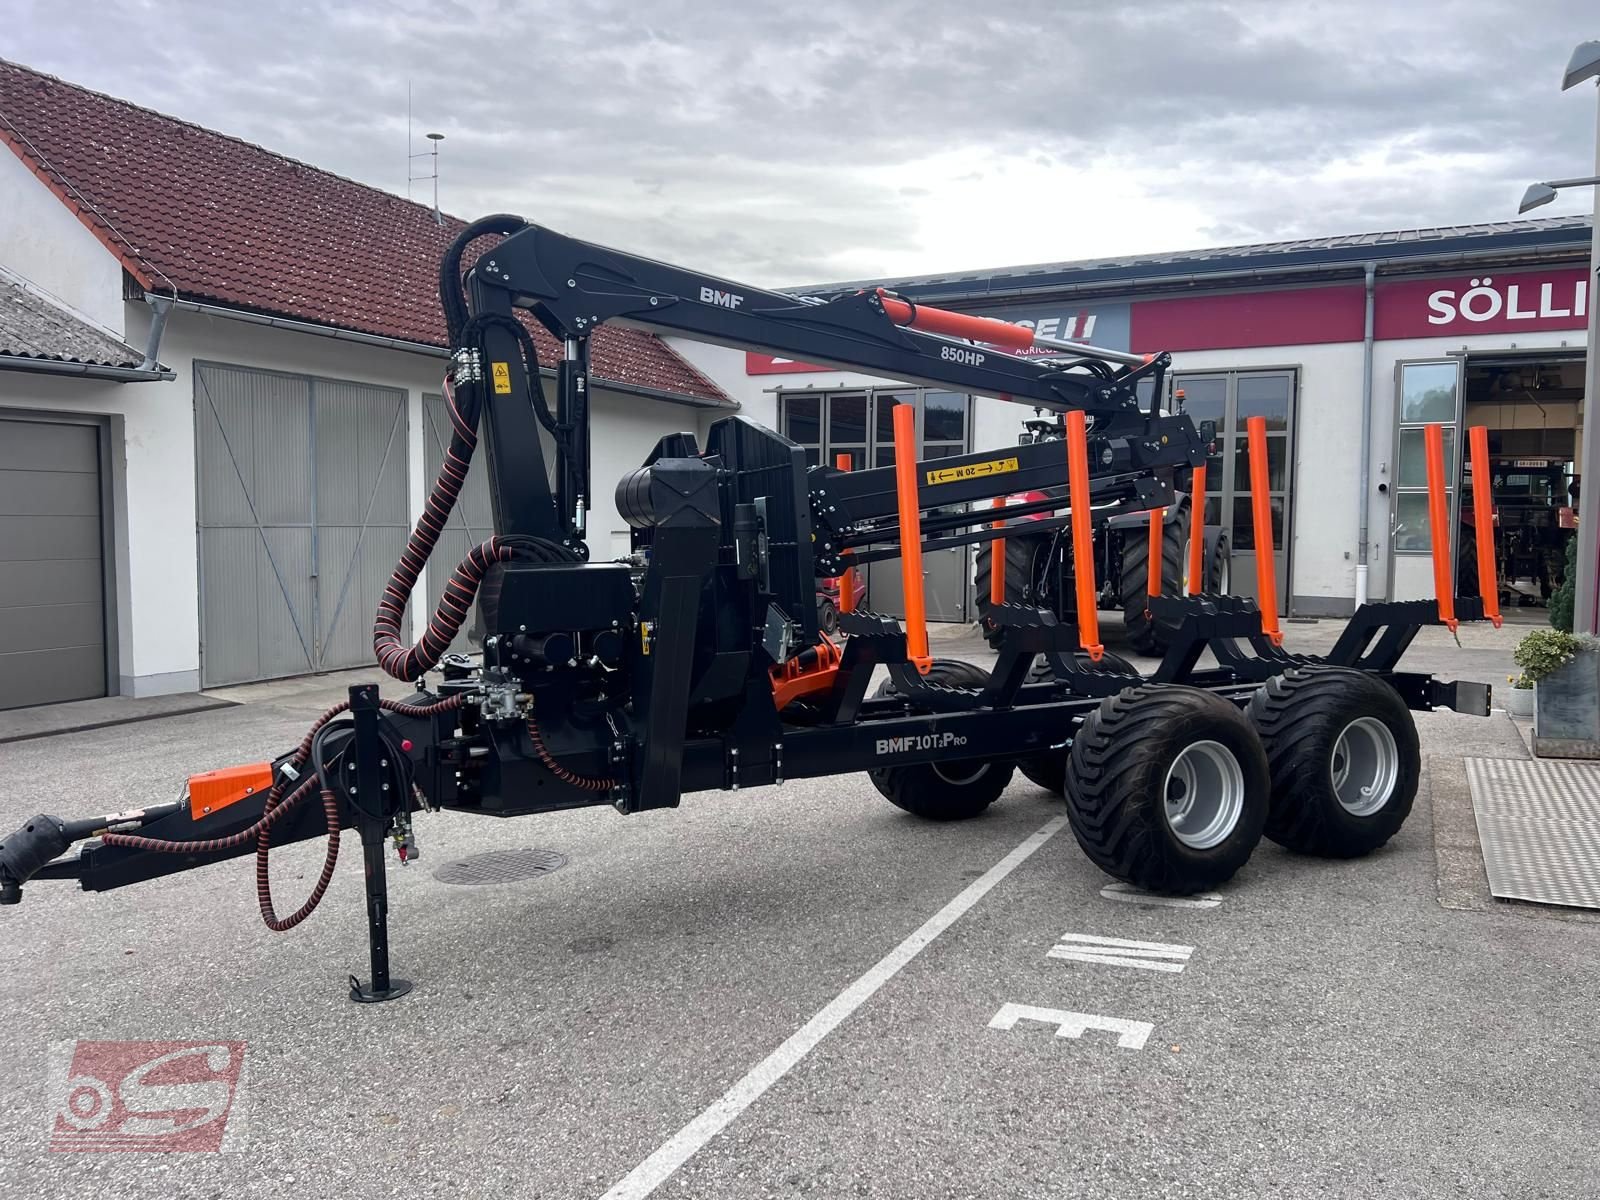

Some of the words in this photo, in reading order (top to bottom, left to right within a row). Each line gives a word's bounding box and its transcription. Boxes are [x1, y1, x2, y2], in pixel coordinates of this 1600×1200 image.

[699, 286, 745, 309] BMF
[1427, 277, 1587, 325] SÖLLI
[940, 346, 985, 367] 850HP
[965, 467, 975, 476] 20
